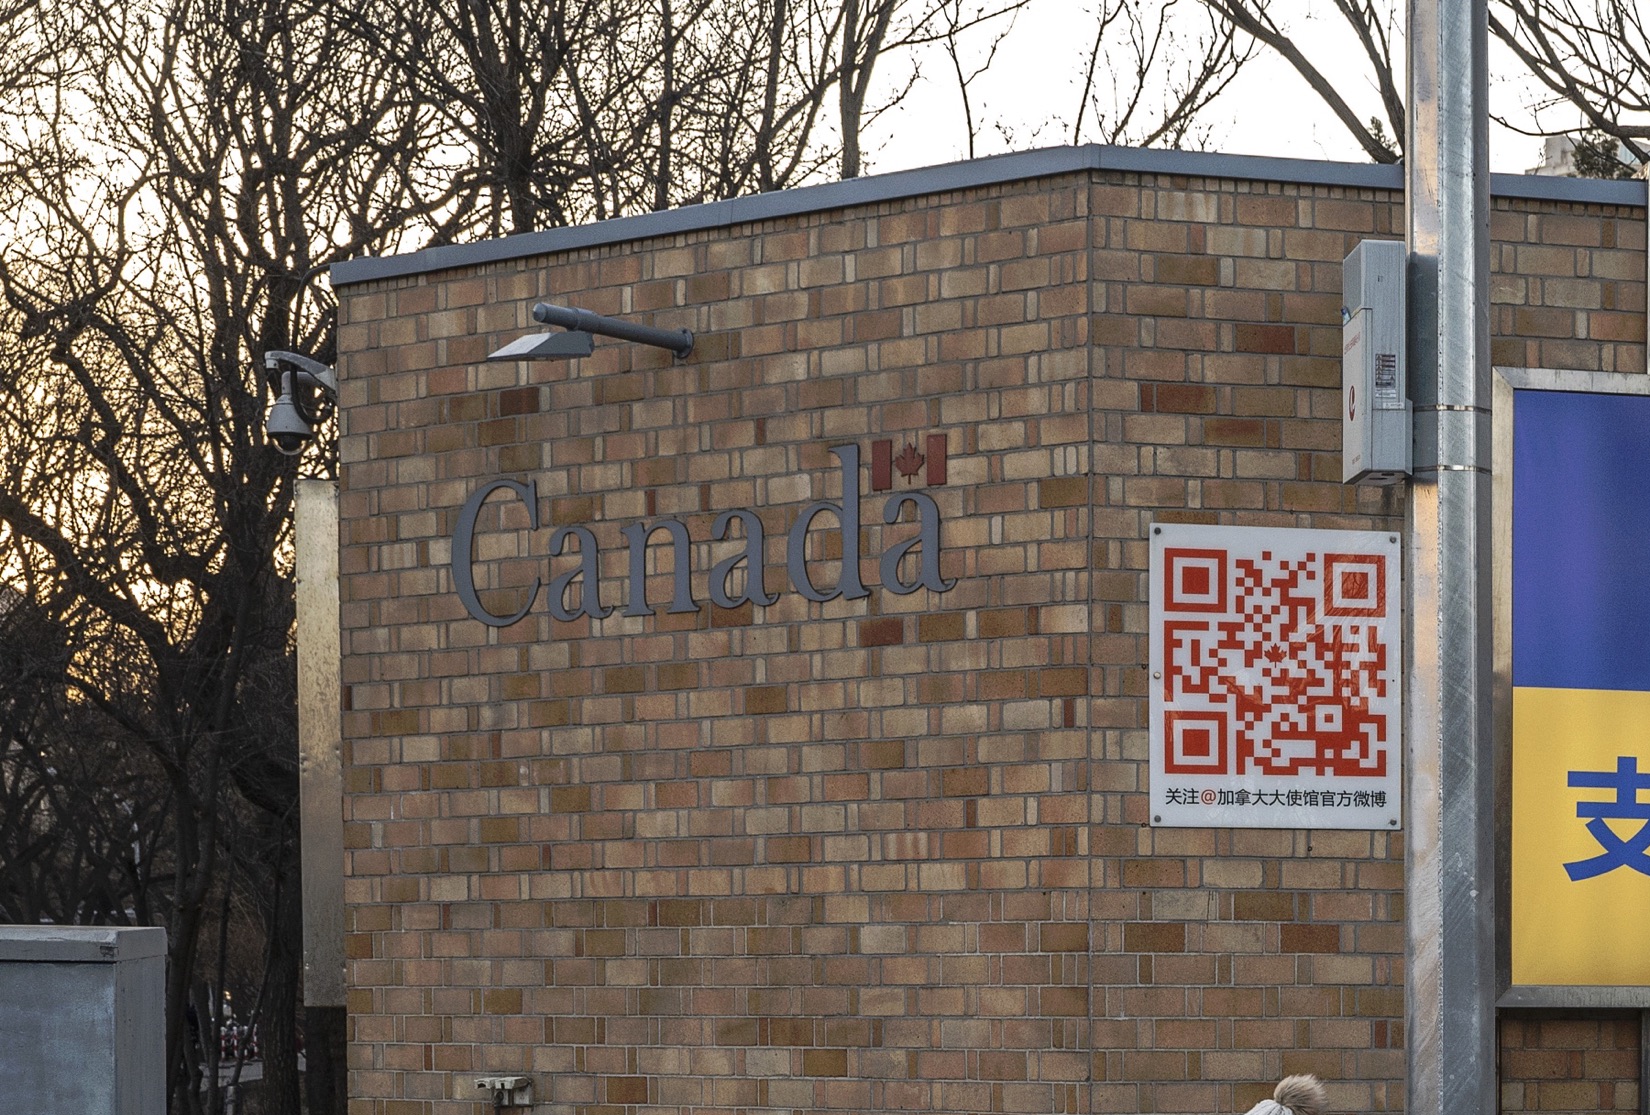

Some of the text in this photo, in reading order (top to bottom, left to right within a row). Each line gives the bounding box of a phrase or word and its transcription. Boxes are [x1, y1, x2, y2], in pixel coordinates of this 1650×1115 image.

[451, 443, 957, 627] Canada
[1165, 788, 1387, 808] 关注@加拿大大使馆官方微博
